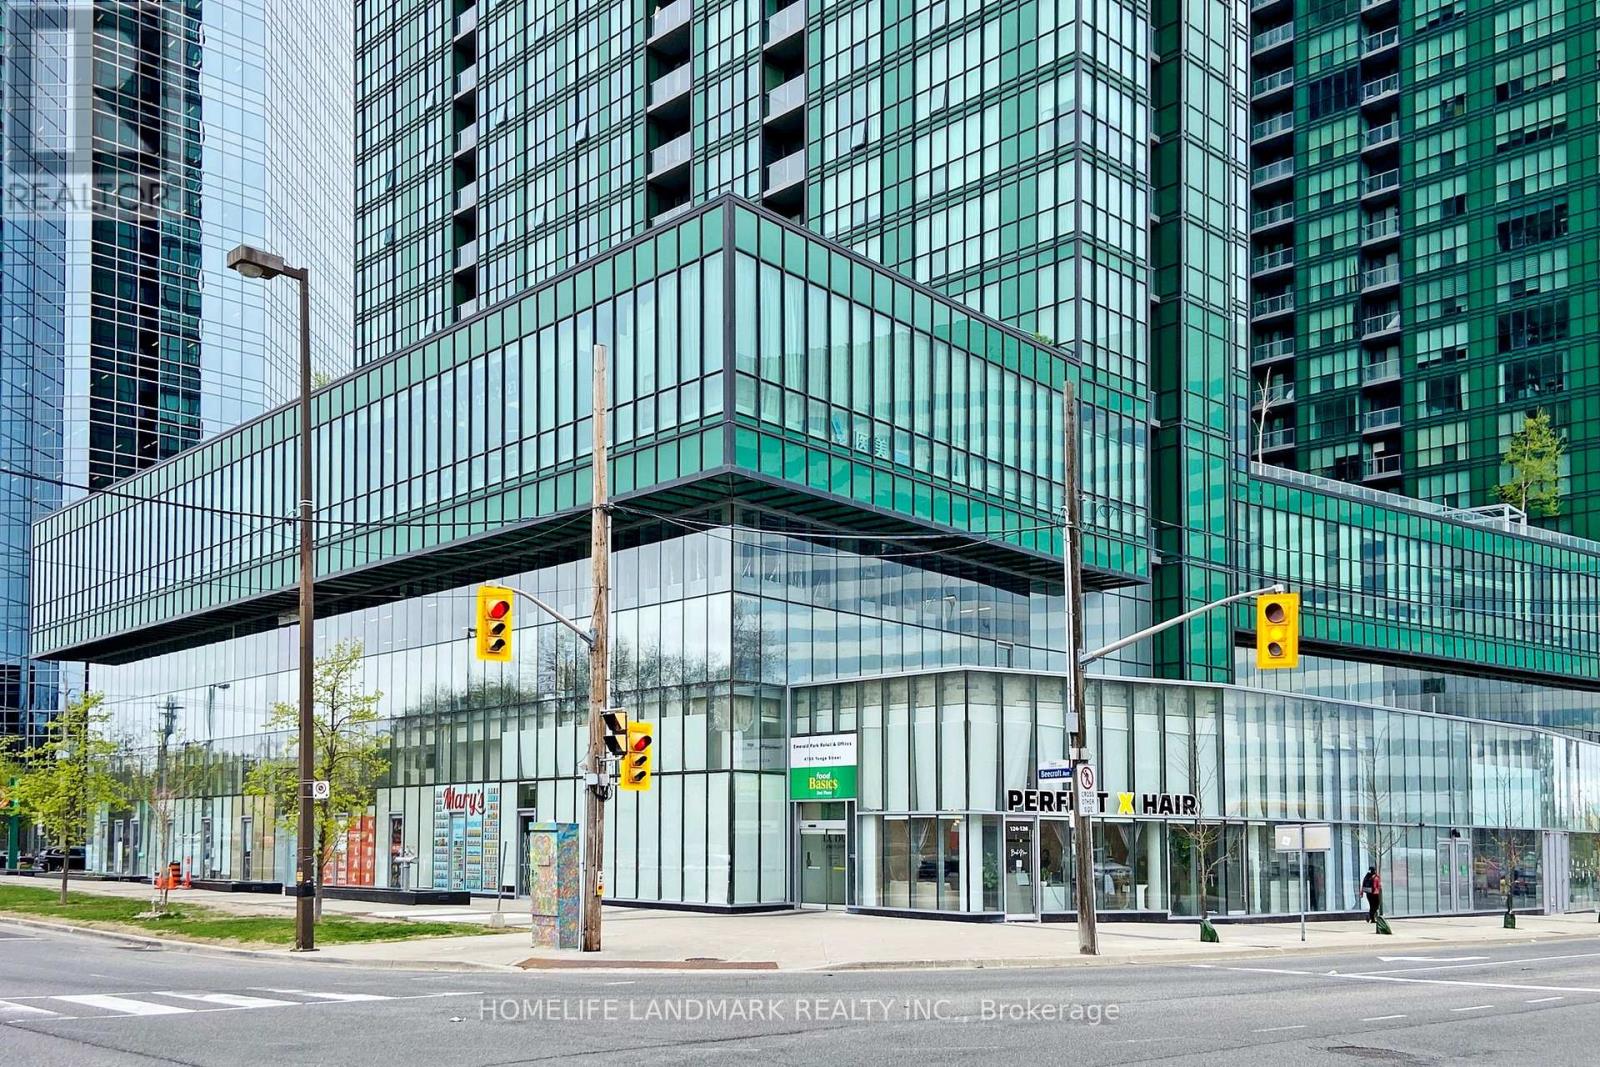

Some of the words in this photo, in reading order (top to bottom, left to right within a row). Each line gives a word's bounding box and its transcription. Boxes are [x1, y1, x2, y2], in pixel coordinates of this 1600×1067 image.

[815, 771, 831, 779] food
[1040, 770, 1062, 778] Beecroft
[809, 777, 838, 791] Basics
[443, 786, 487, 817] Mary's
[1007, 790, 1109, 813] PERFT
[1118, 792, 1135, 814] X
[1142, 793, 1199, 816] HAIR
